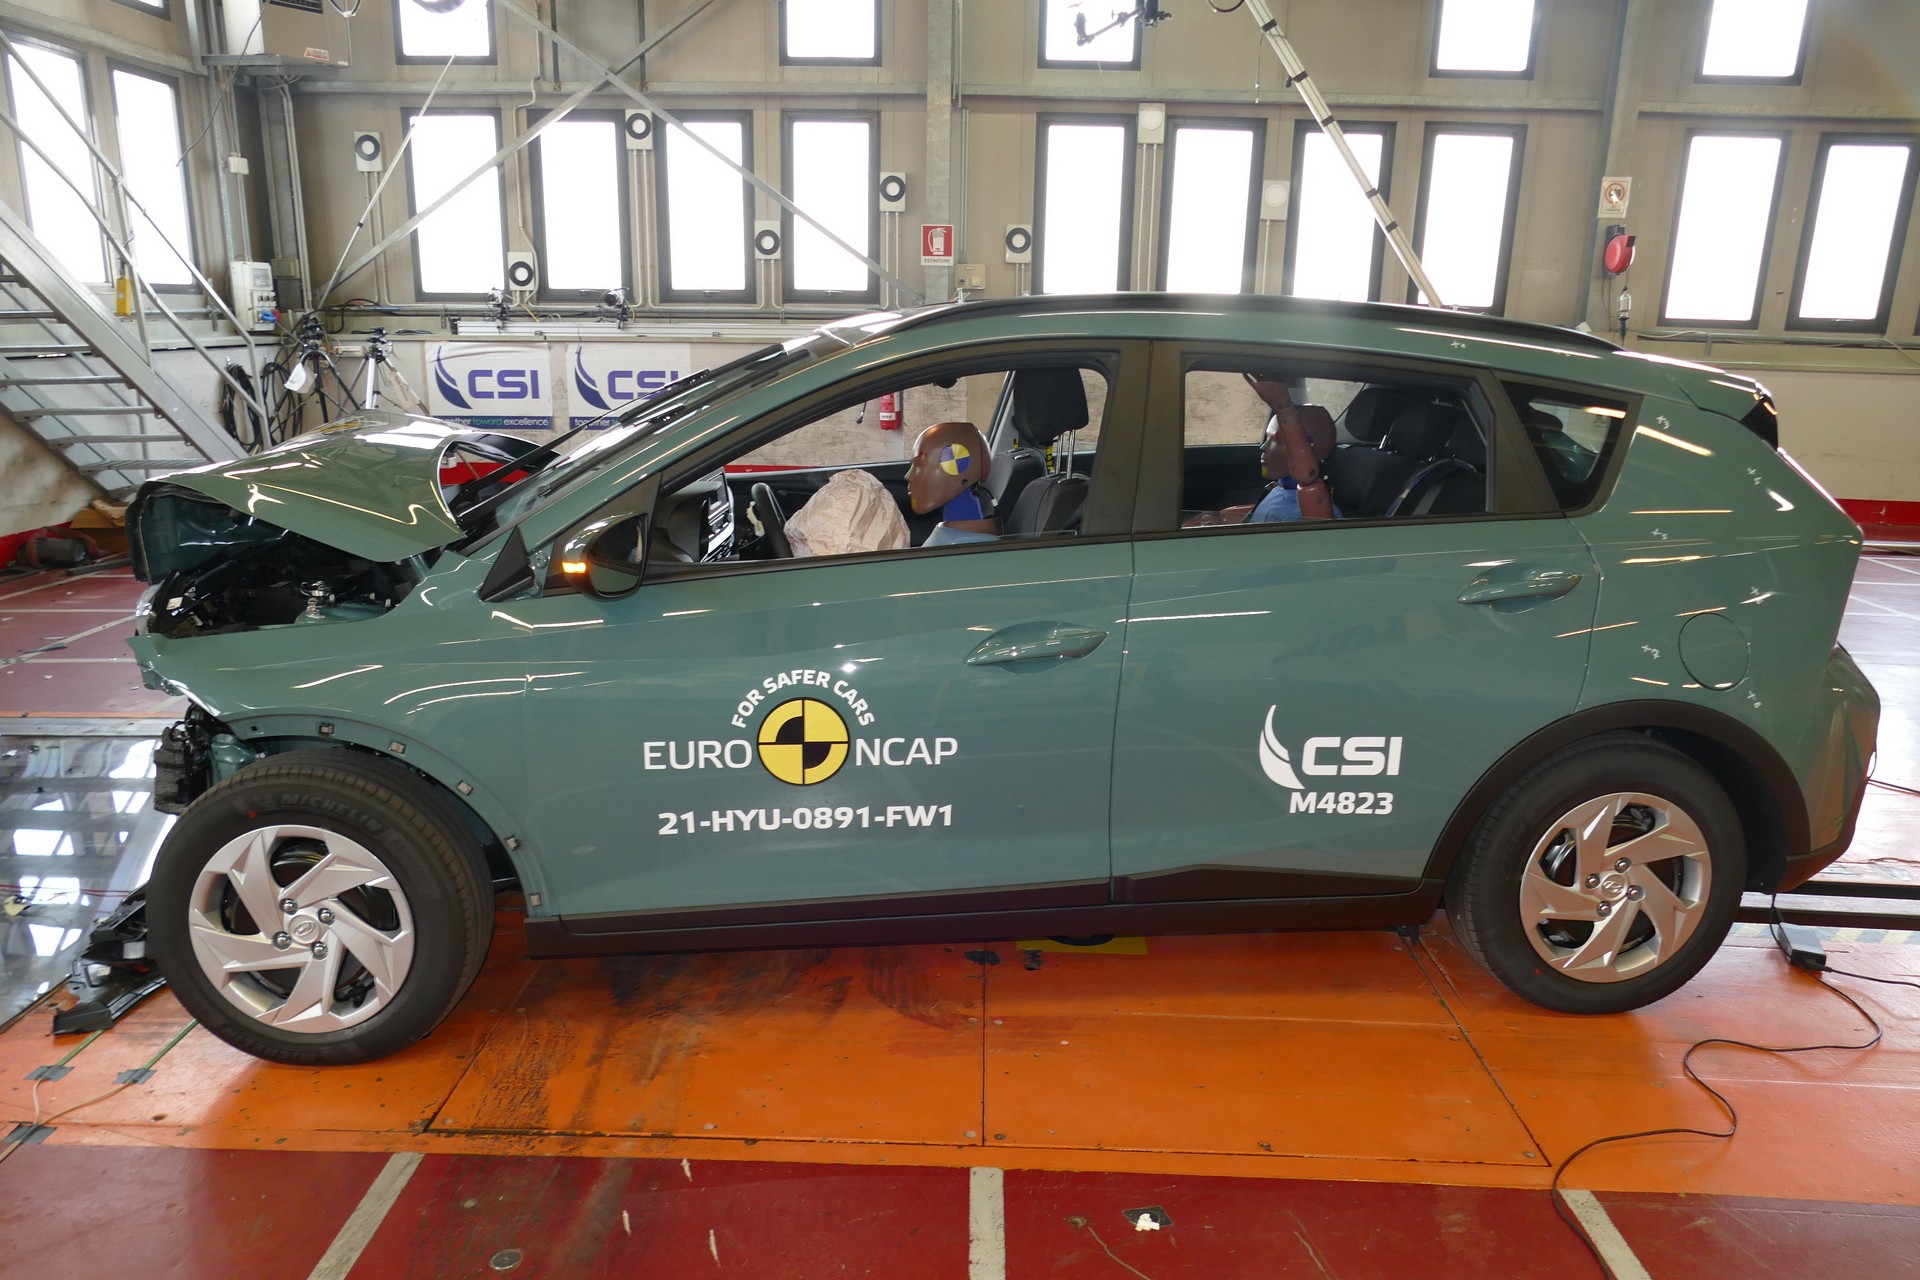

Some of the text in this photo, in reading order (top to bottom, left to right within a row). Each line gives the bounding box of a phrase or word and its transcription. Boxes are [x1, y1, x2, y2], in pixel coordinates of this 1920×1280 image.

[468, 369, 540, 399] CSI
[472, 418, 502, 426] toward
[503, 417, 549, 426] excellence
[731, 669, 875, 728] FOR SAFER CARS
[643, 737, 958, 770] EURO NCAP
[1301, 736, 1403, 776] CSI
[279, 793, 384, 832] MICHELIN
[1289, 791, 1394, 815] M4823
[657, 804, 953, 836] 21-HYU-0891-FW1
